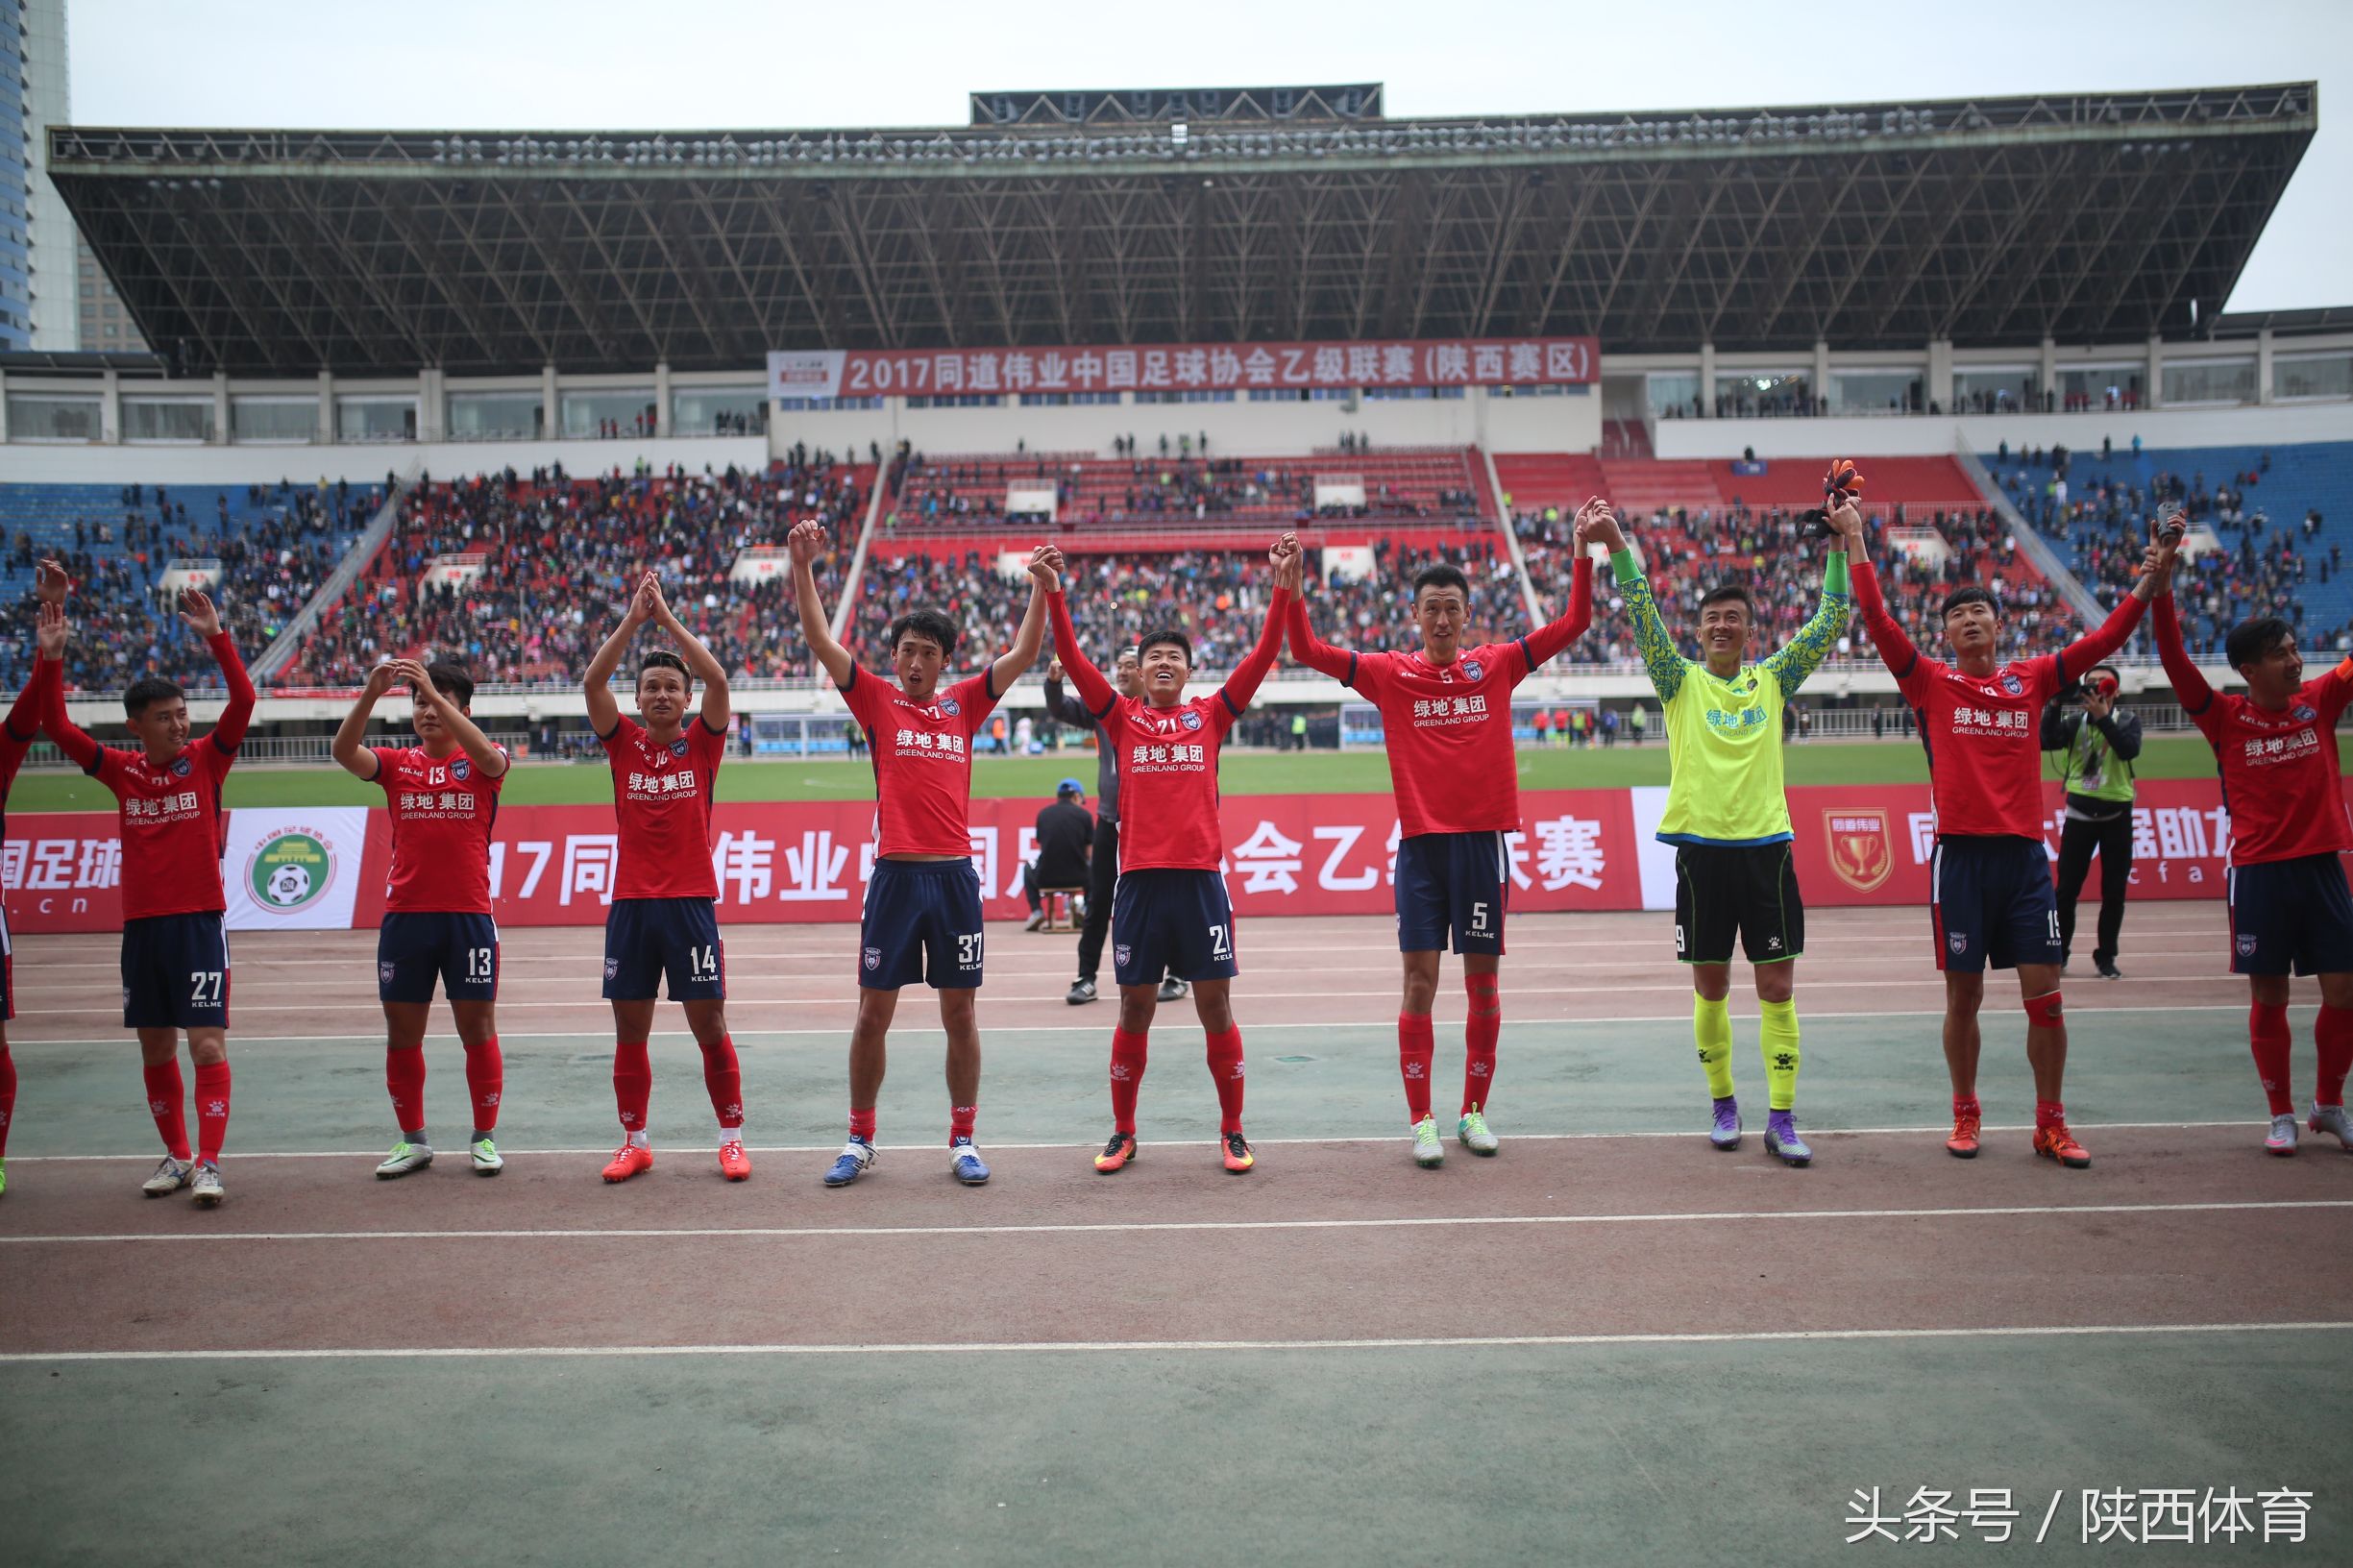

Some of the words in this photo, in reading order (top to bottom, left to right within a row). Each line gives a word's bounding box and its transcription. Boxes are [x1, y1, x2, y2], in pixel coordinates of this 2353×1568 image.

[1439, 668, 1454, 684] 5
[1131, 715, 1156, 733] KELME
[1413, 717, 1461, 727] GREENLAND
[1463, 713, 1490, 723] GROUP
[1952, 726, 2002, 737] GREENLAND
[2004, 730, 2029, 739] GROUP
[895, 748, 944, 759] GREENLAND
[944, 752, 966, 764] GROUP
[429, 766, 446, 785] 13
[1131, 764, 1179, 773] GREENLAND
[1180, 764, 1206, 772] GROUP
[626, 792, 670, 801] GREENLAND
[671, 789, 698, 800] GROUP
[125, 815, 170, 826] GREENLAND
[170, 810, 201, 821] GROUP
[400, 811, 446, 821] GREENLAND
[447, 811, 477, 821] GROUP
[1472, 901, 1488, 930] 5
[1209, 922, 1231, 955] 21
[1465, 930, 1495, 939] KELME
[958, 931, 983, 964] 37
[468, 947, 492, 976] 13
[690, 944, 717, 975] 14
[191, 971, 223, 1000] 27
